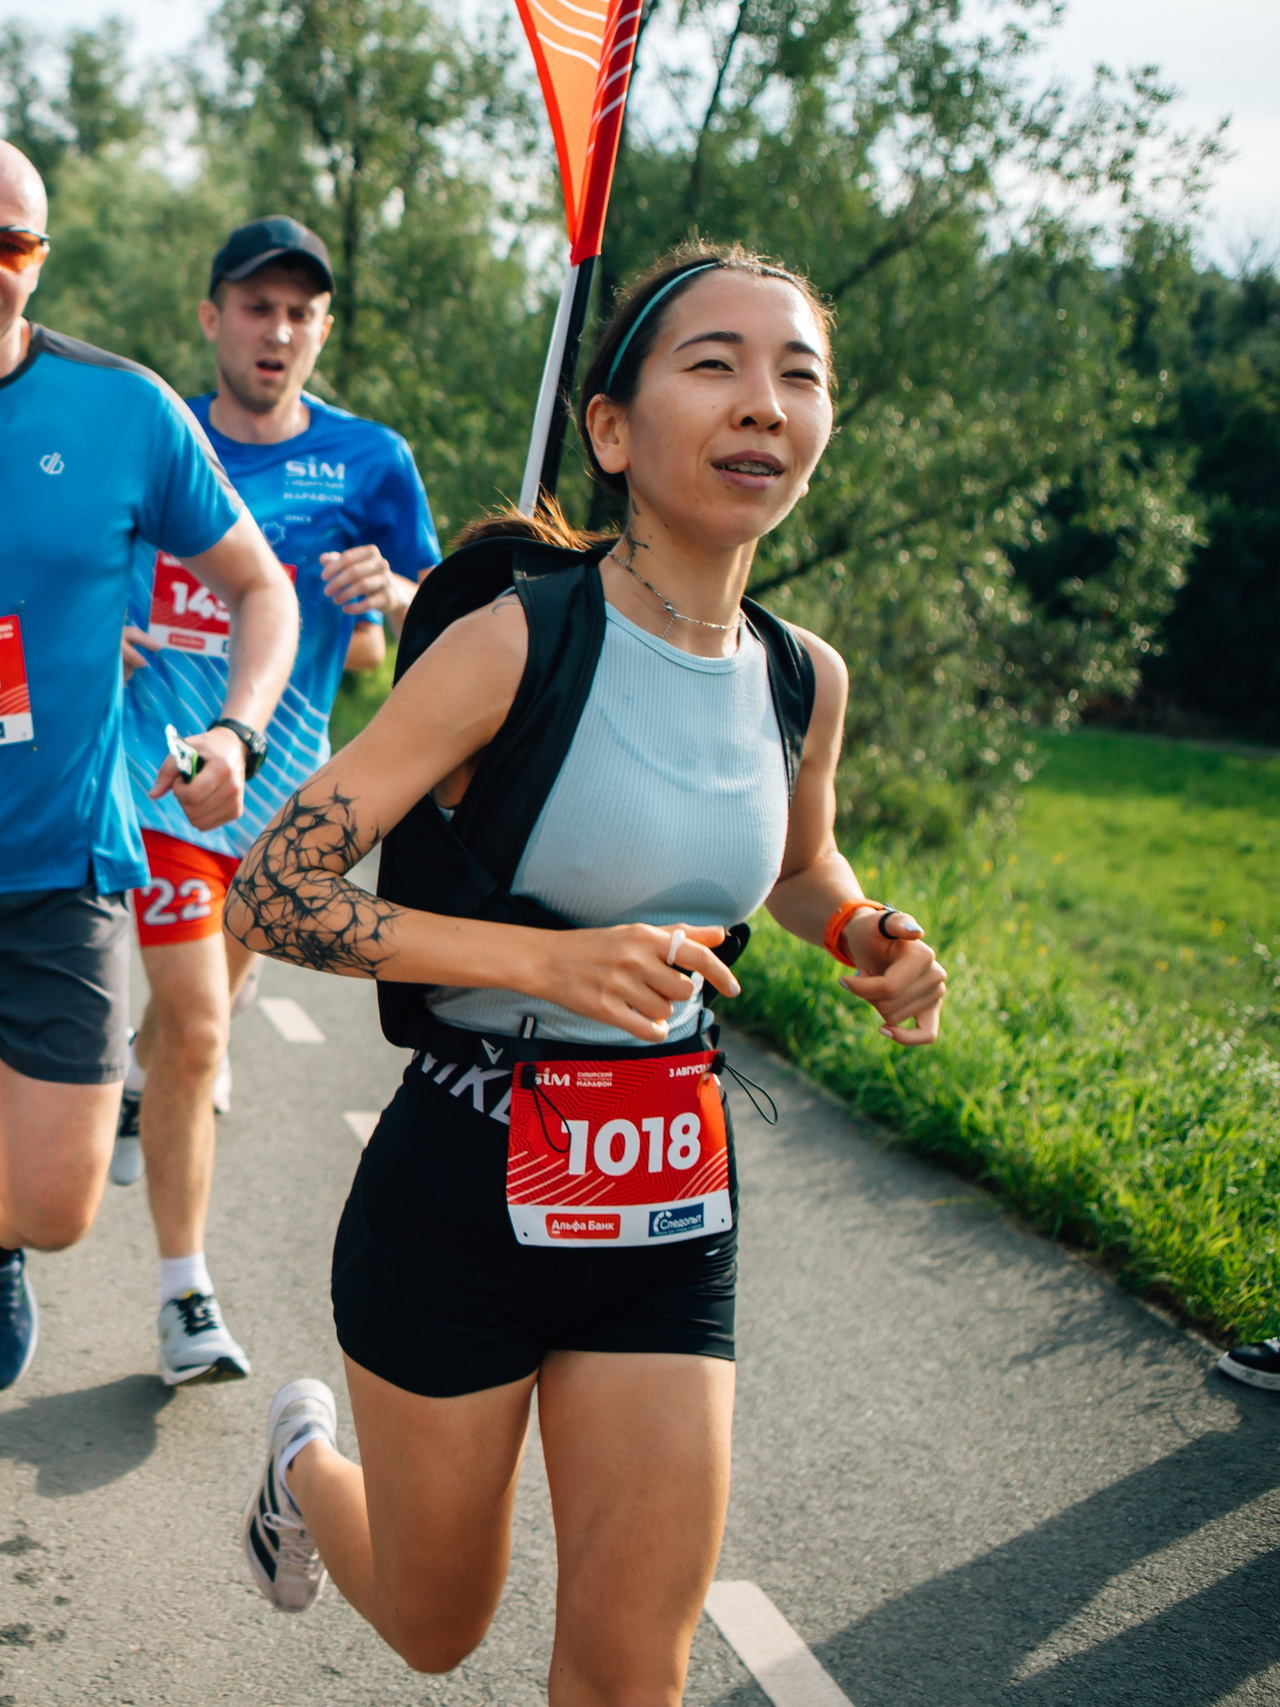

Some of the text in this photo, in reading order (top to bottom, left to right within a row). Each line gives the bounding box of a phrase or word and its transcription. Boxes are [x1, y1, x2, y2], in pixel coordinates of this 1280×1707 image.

[561, 1112, 702, 1177] 1018
[551, 1219, 615, 1232] Альфа Банк
